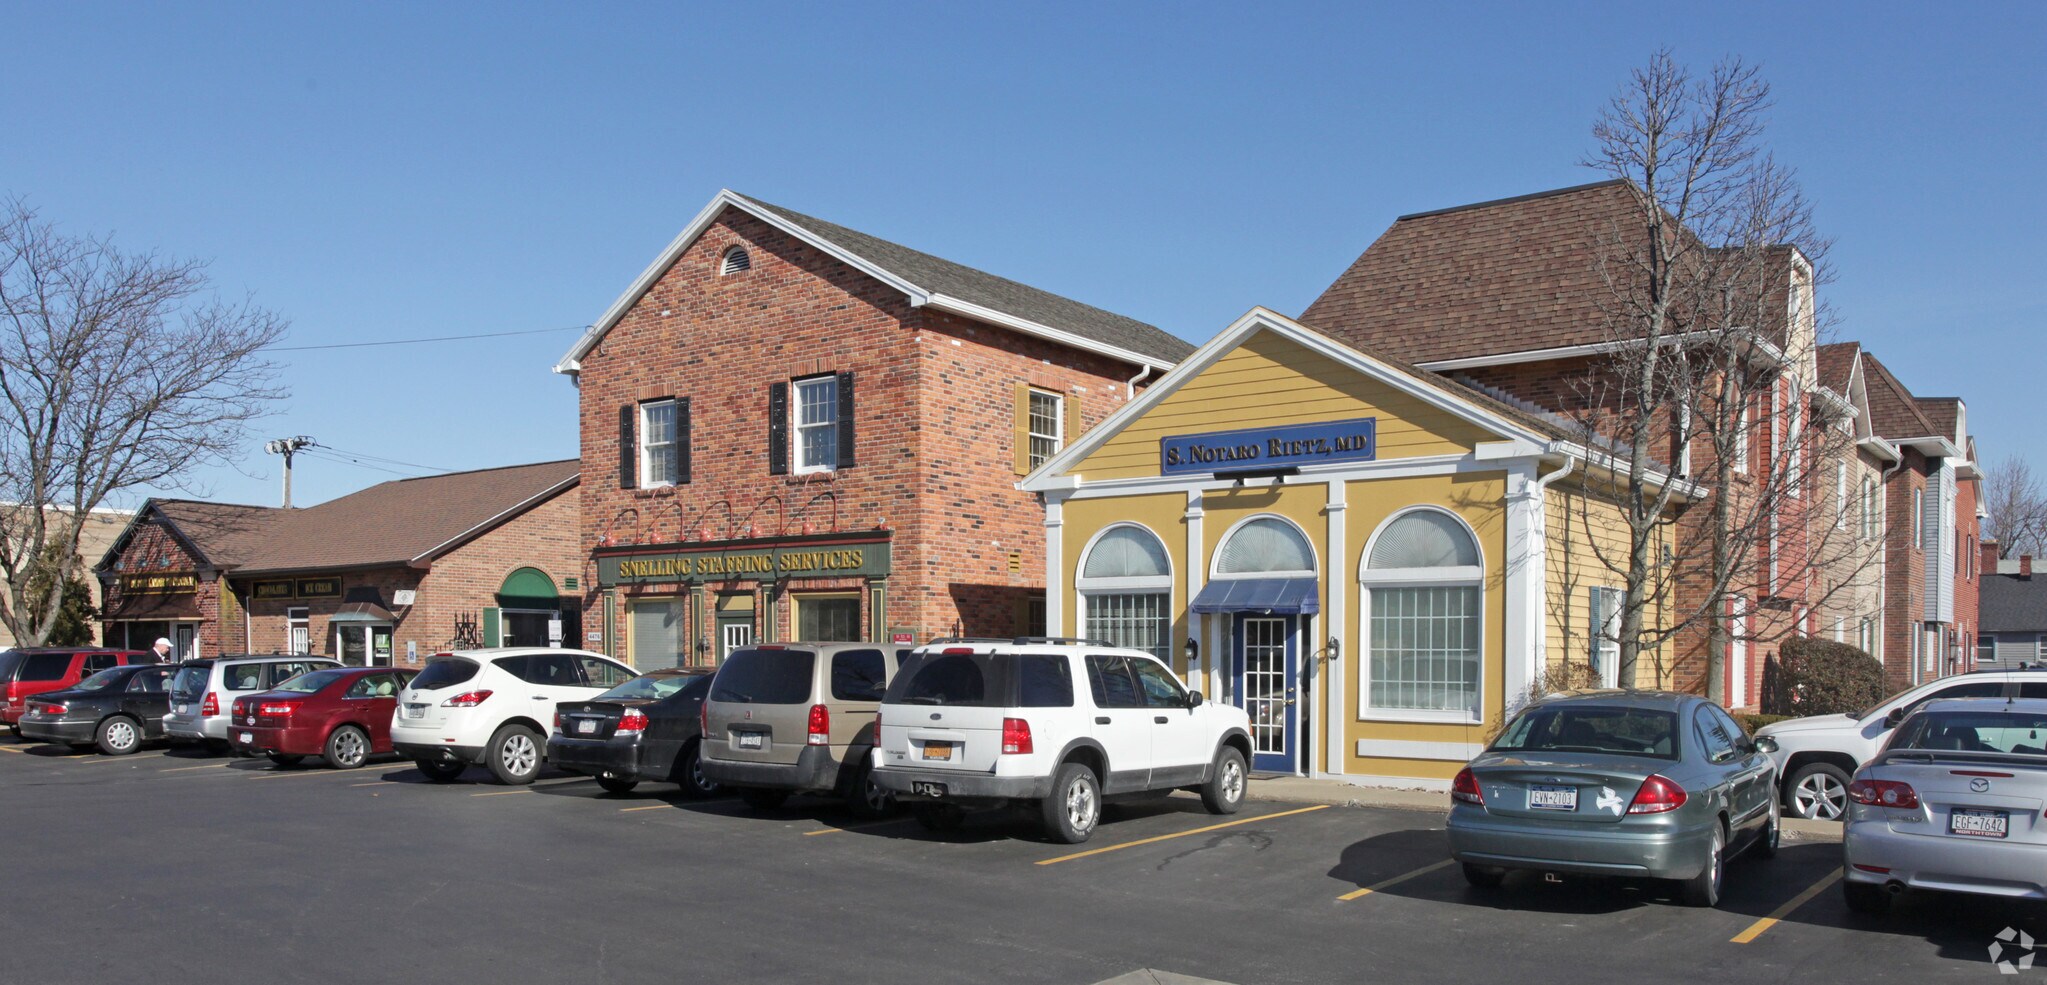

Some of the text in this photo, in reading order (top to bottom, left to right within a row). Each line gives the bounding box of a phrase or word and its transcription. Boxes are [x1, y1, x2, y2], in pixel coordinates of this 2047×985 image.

[1167, 446, 1186, 465] S.
[1190, 444, 1261, 464] NOTARO
[1335, 434, 1368, 453] MD
[619, 550, 864, 578] SNELLING STAFFING SERVICES
[1955, 829, 2003, 837] NORTHTOWN
